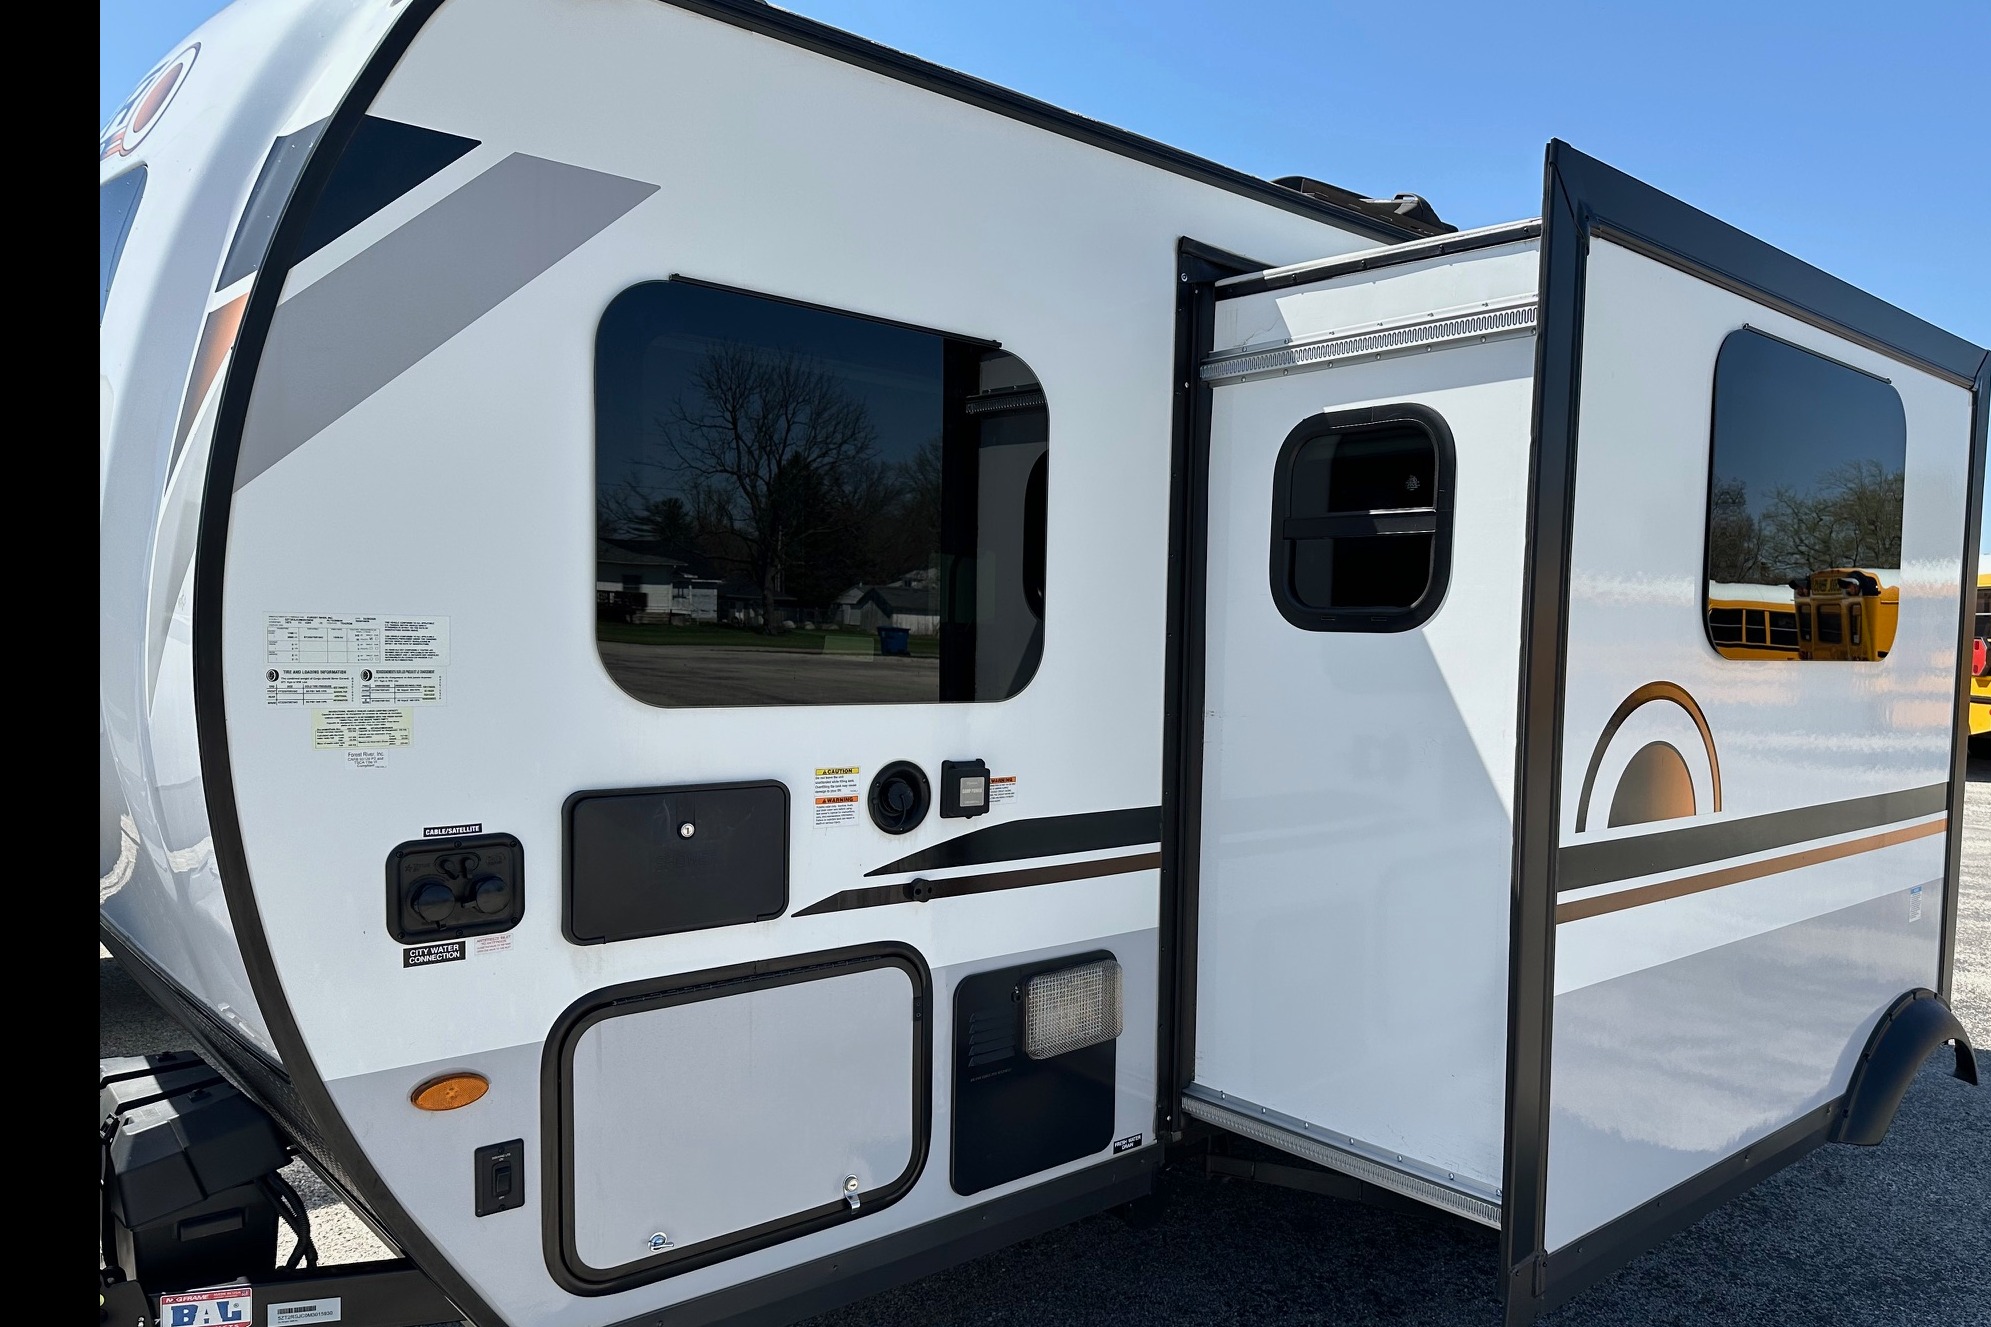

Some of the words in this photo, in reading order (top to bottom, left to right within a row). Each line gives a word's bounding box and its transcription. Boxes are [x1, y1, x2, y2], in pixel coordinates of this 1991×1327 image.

[426, 825, 479, 835] CABLE/SATELLITE
[410, 948, 429, 957] CITY
[430, 944, 459, 954] WATER
[409, 951, 460, 964] CONNECTION
[1115, 1140, 1127, 1148] FRESH
[1121, 1142, 1133, 1150] DRAIN
[171, 1301, 241, 1327] BAL
